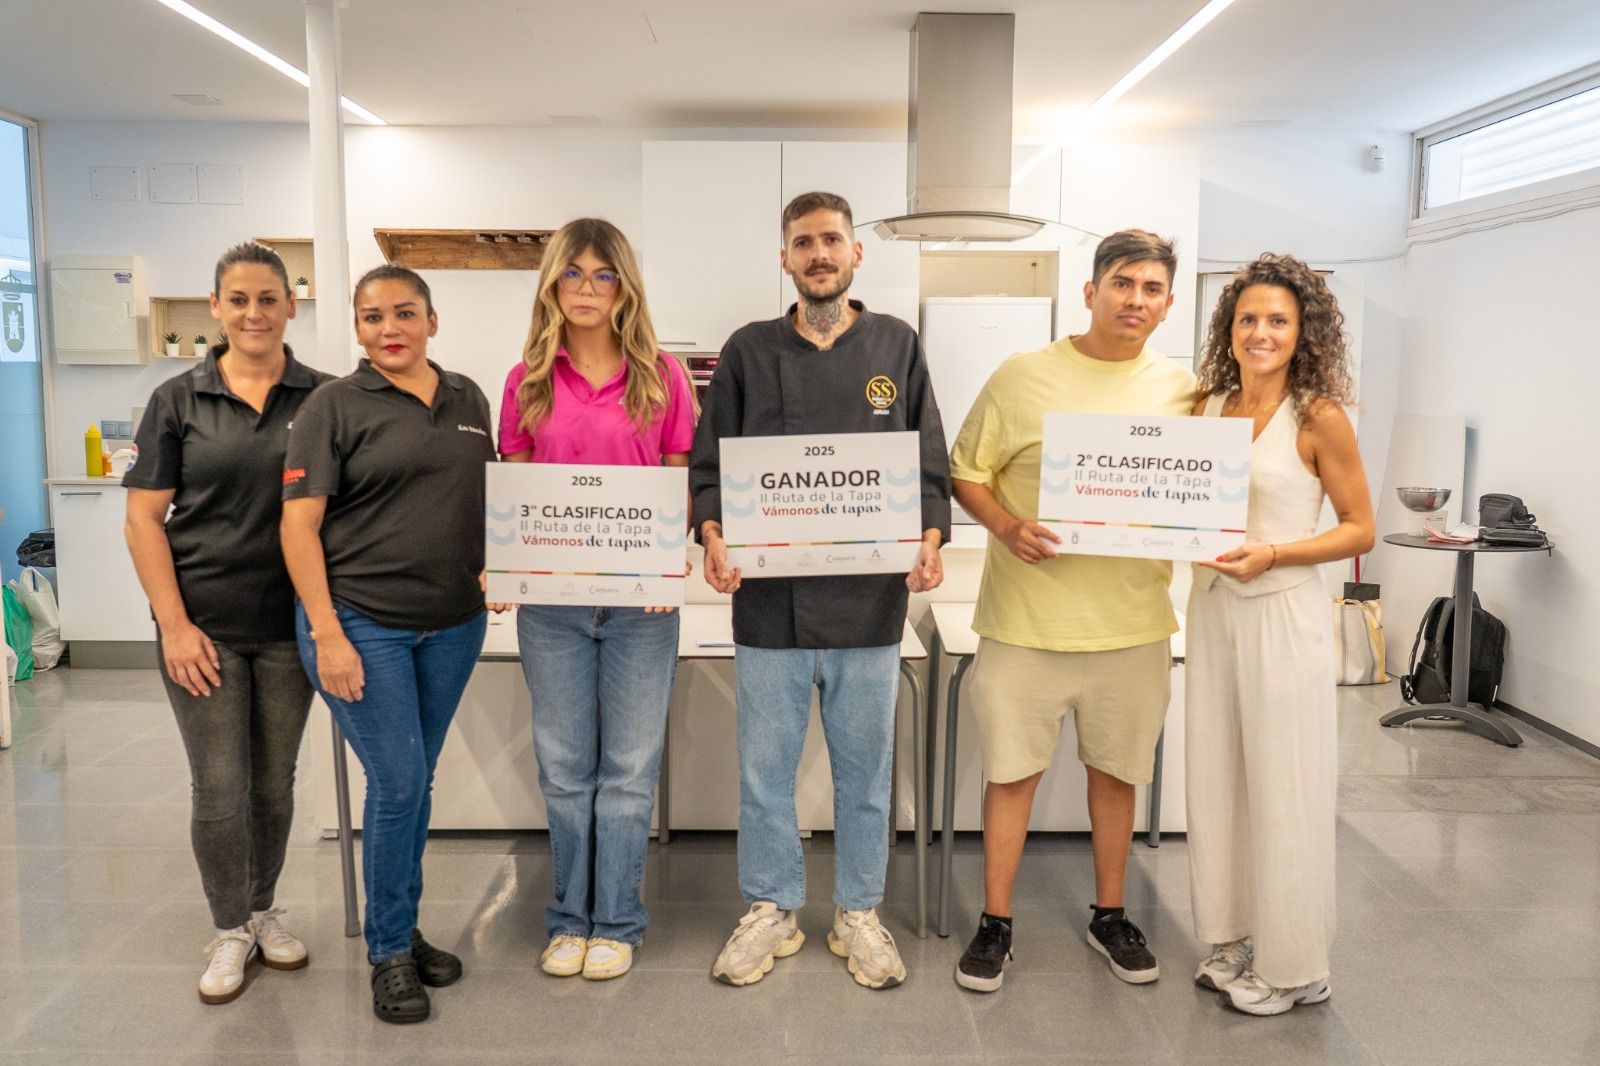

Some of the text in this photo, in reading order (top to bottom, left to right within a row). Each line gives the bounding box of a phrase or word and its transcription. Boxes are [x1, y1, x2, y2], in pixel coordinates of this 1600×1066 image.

[1130, 425, 1162, 437] 2025
[804, 445, 835, 456] 2025
[1097, 455, 1212, 472] CLASIFICADO
[572, 475, 602, 486] 2025
[760, 470, 880, 490] GANADOR
[1089, 470, 1123, 483] Ruta
[1129, 472, 1149, 484] de
[1154, 473, 1168, 485] la
[1174, 474, 1212, 489] Tapa
[772, 492, 804, 503] Ruta
[809, 491, 827, 502] de
[831, 491, 843, 502] la
[848, 490, 882, 503] Tapa
[1075, 484, 1210, 504] Vámonos de tapas
[542, 505, 652, 520] CLASIFICADO
[762, 503, 882, 517] Vámonos de tapas
[533, 520, 569, 533] Ruta
[573, 521, 592, 533] de
[597, 521, 610, 534] la
[615, 522, 652, 537] Tapa
[521, 534, 651, 552] Vámonos de tapas
